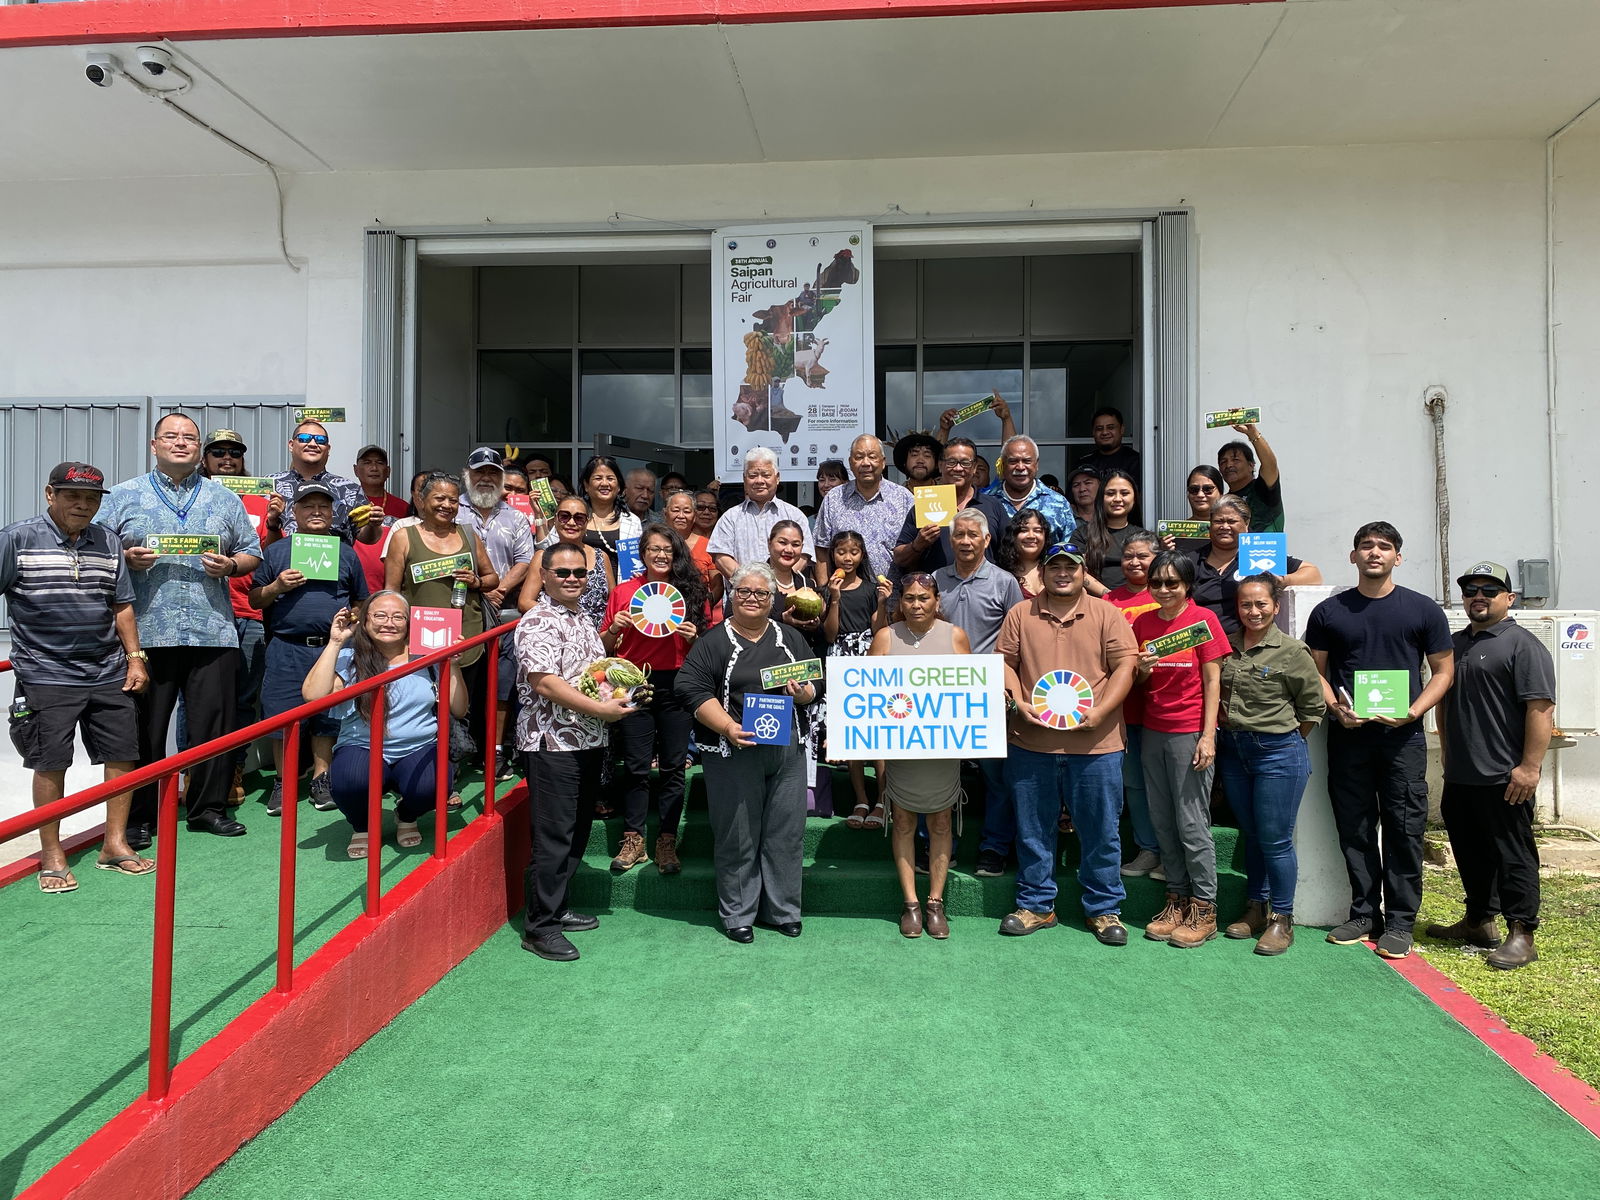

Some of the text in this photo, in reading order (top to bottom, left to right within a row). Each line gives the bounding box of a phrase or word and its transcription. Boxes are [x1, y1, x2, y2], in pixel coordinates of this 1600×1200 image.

[731, 266, 772, 278] Saipan
[731, 277, 797, 291] Agricultural
[731, 292, 752, 302] Fair
[917, 489, 922, 498] 2
[295, 536, 301, 546] 3
[1241, 536, 1250, 545] 14
[618, 542, 627, 551] 16
[438, 558, 456, 566] FARM!
[414, 610, 420, 620] 4
[1155, 630, 1192, 648] LET'S FARM!
[788, 664, 807, 672] FARM!
[844, 667, 986, 687] CNMI GREEN
[1357, 674, 1368, 684] 15
[746, 697, 756, 708] 17
[844, 692, 988, 719] GROWTH
[845, 725, 988, 750] INITIATIVE
